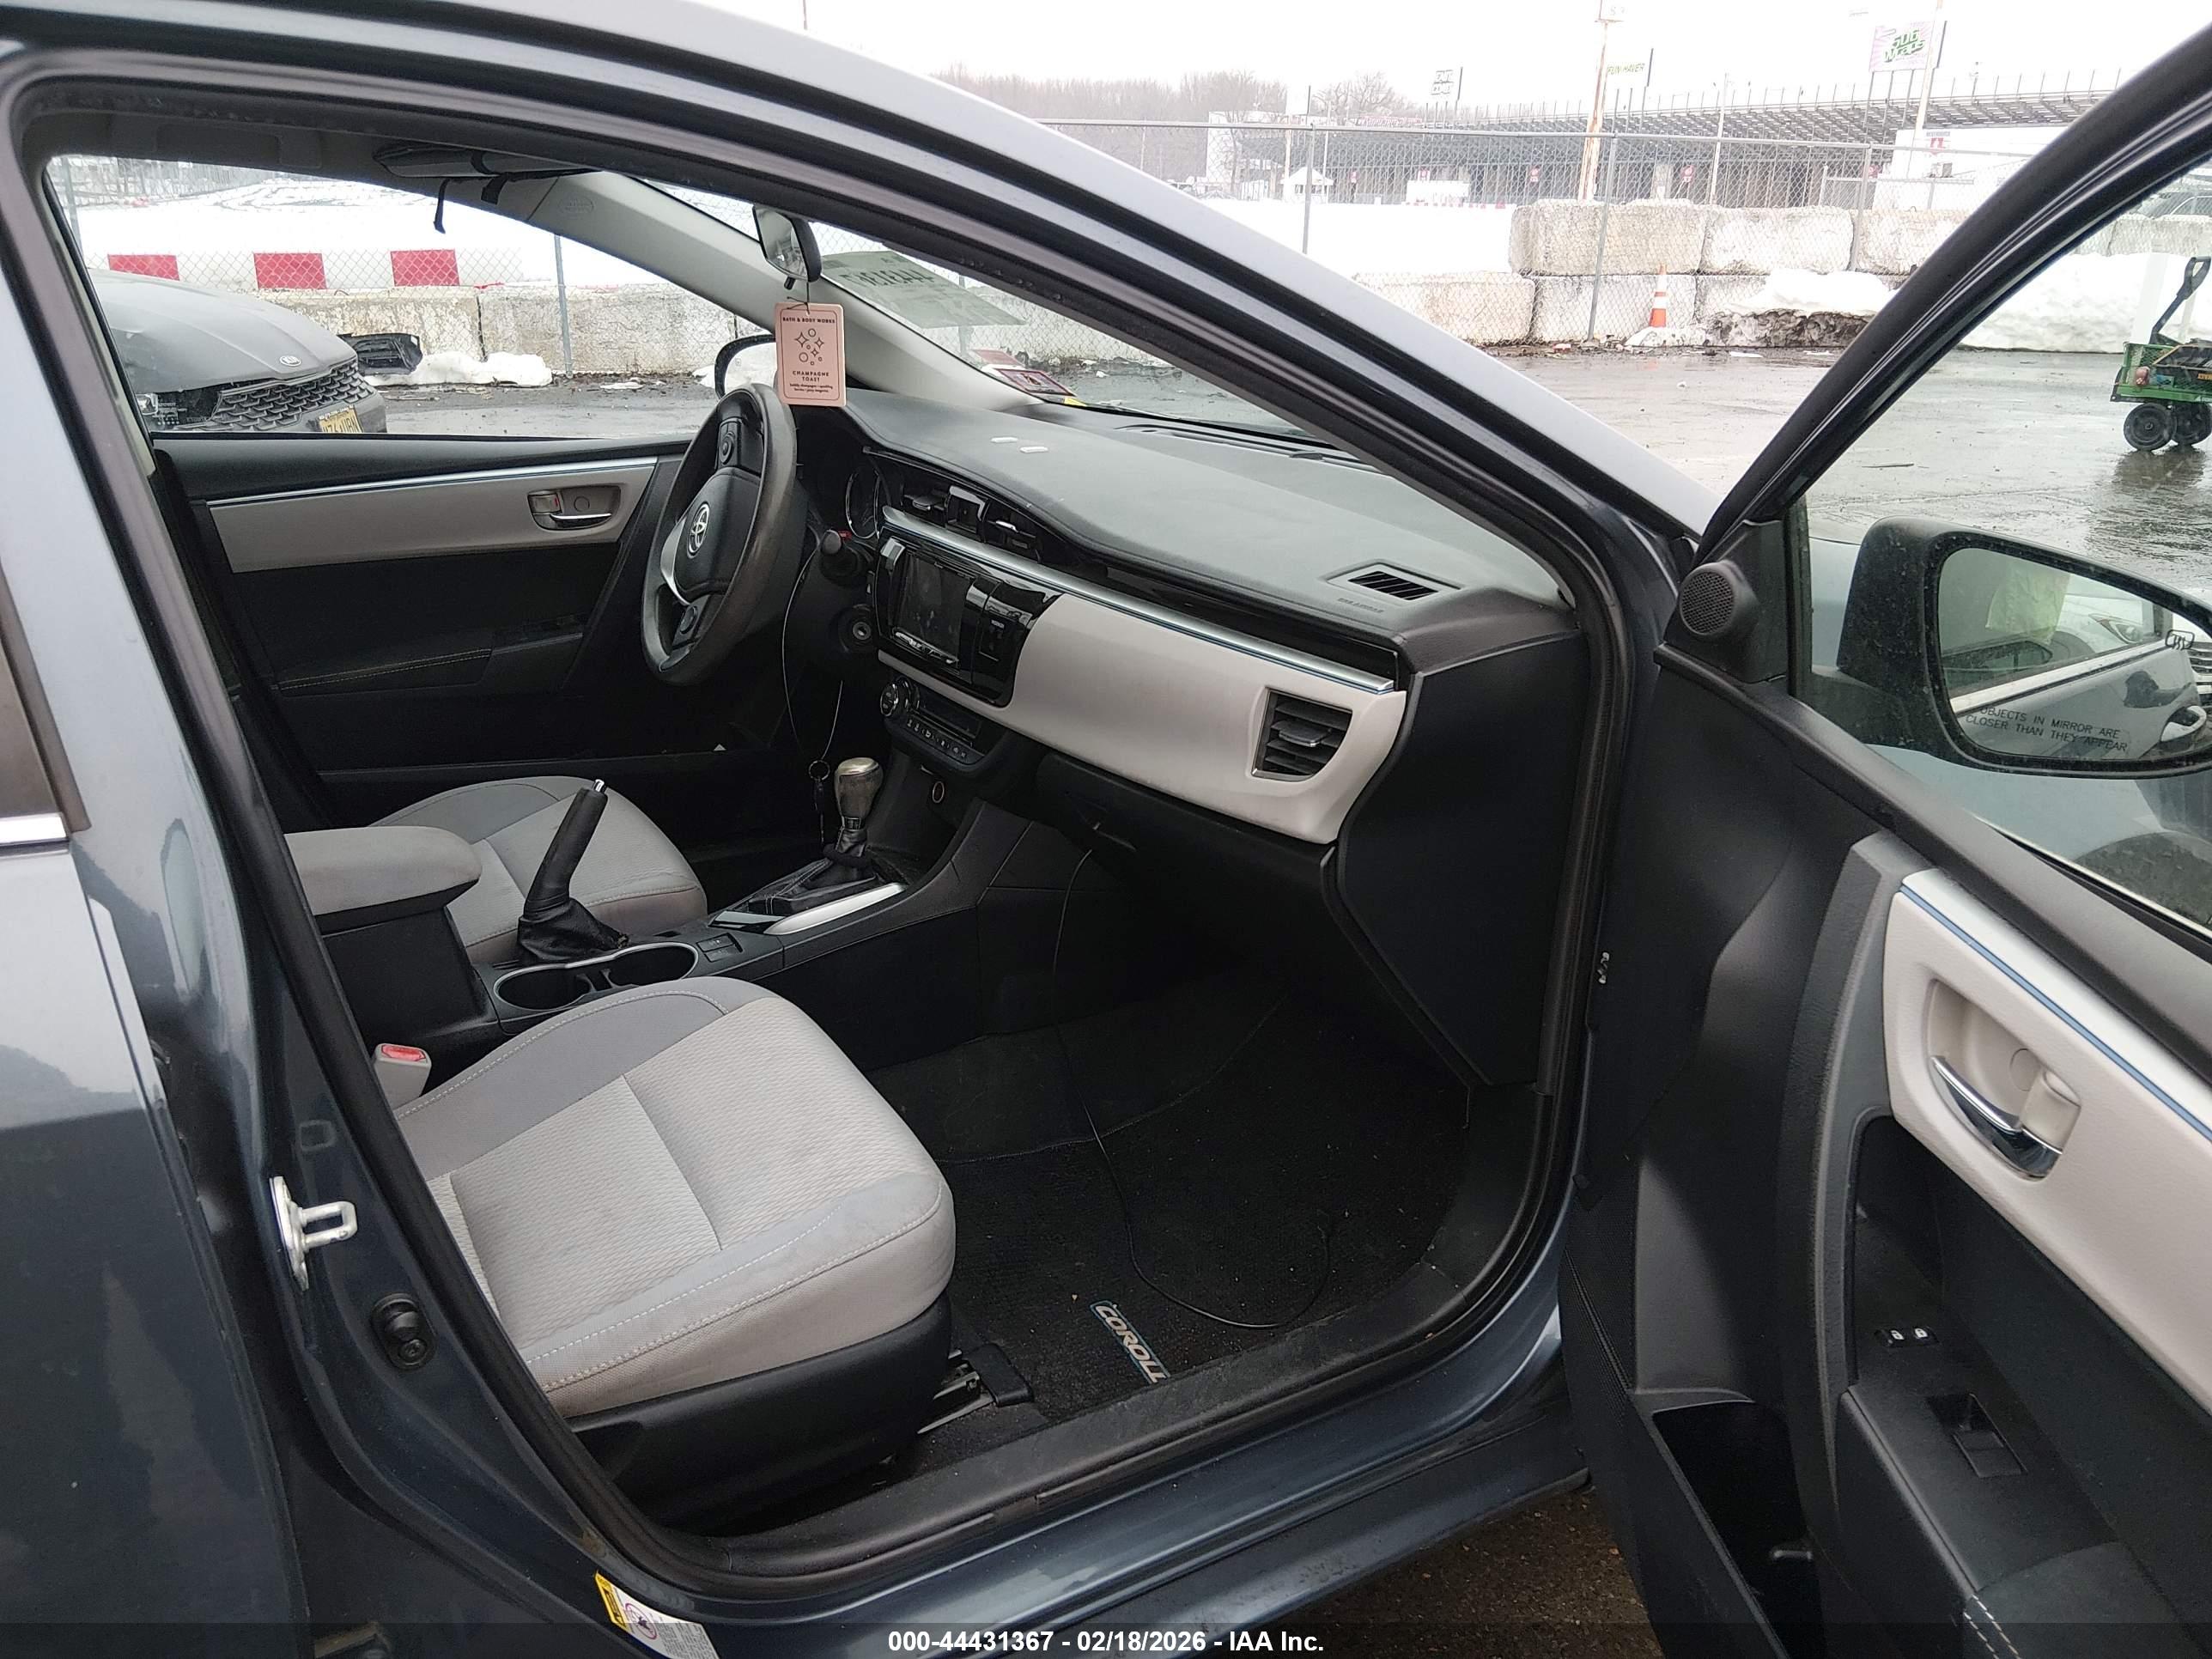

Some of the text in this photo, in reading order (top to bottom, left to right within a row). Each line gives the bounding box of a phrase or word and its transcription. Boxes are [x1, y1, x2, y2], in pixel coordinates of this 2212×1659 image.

[1966, 714, 2128, 752] CLOSER THAN THEY APPEAR
[1979, 707, 2121, 739] OBJECTS IN MIRROR ARE
[1095, 1305, 1167, 1383] COROLL
